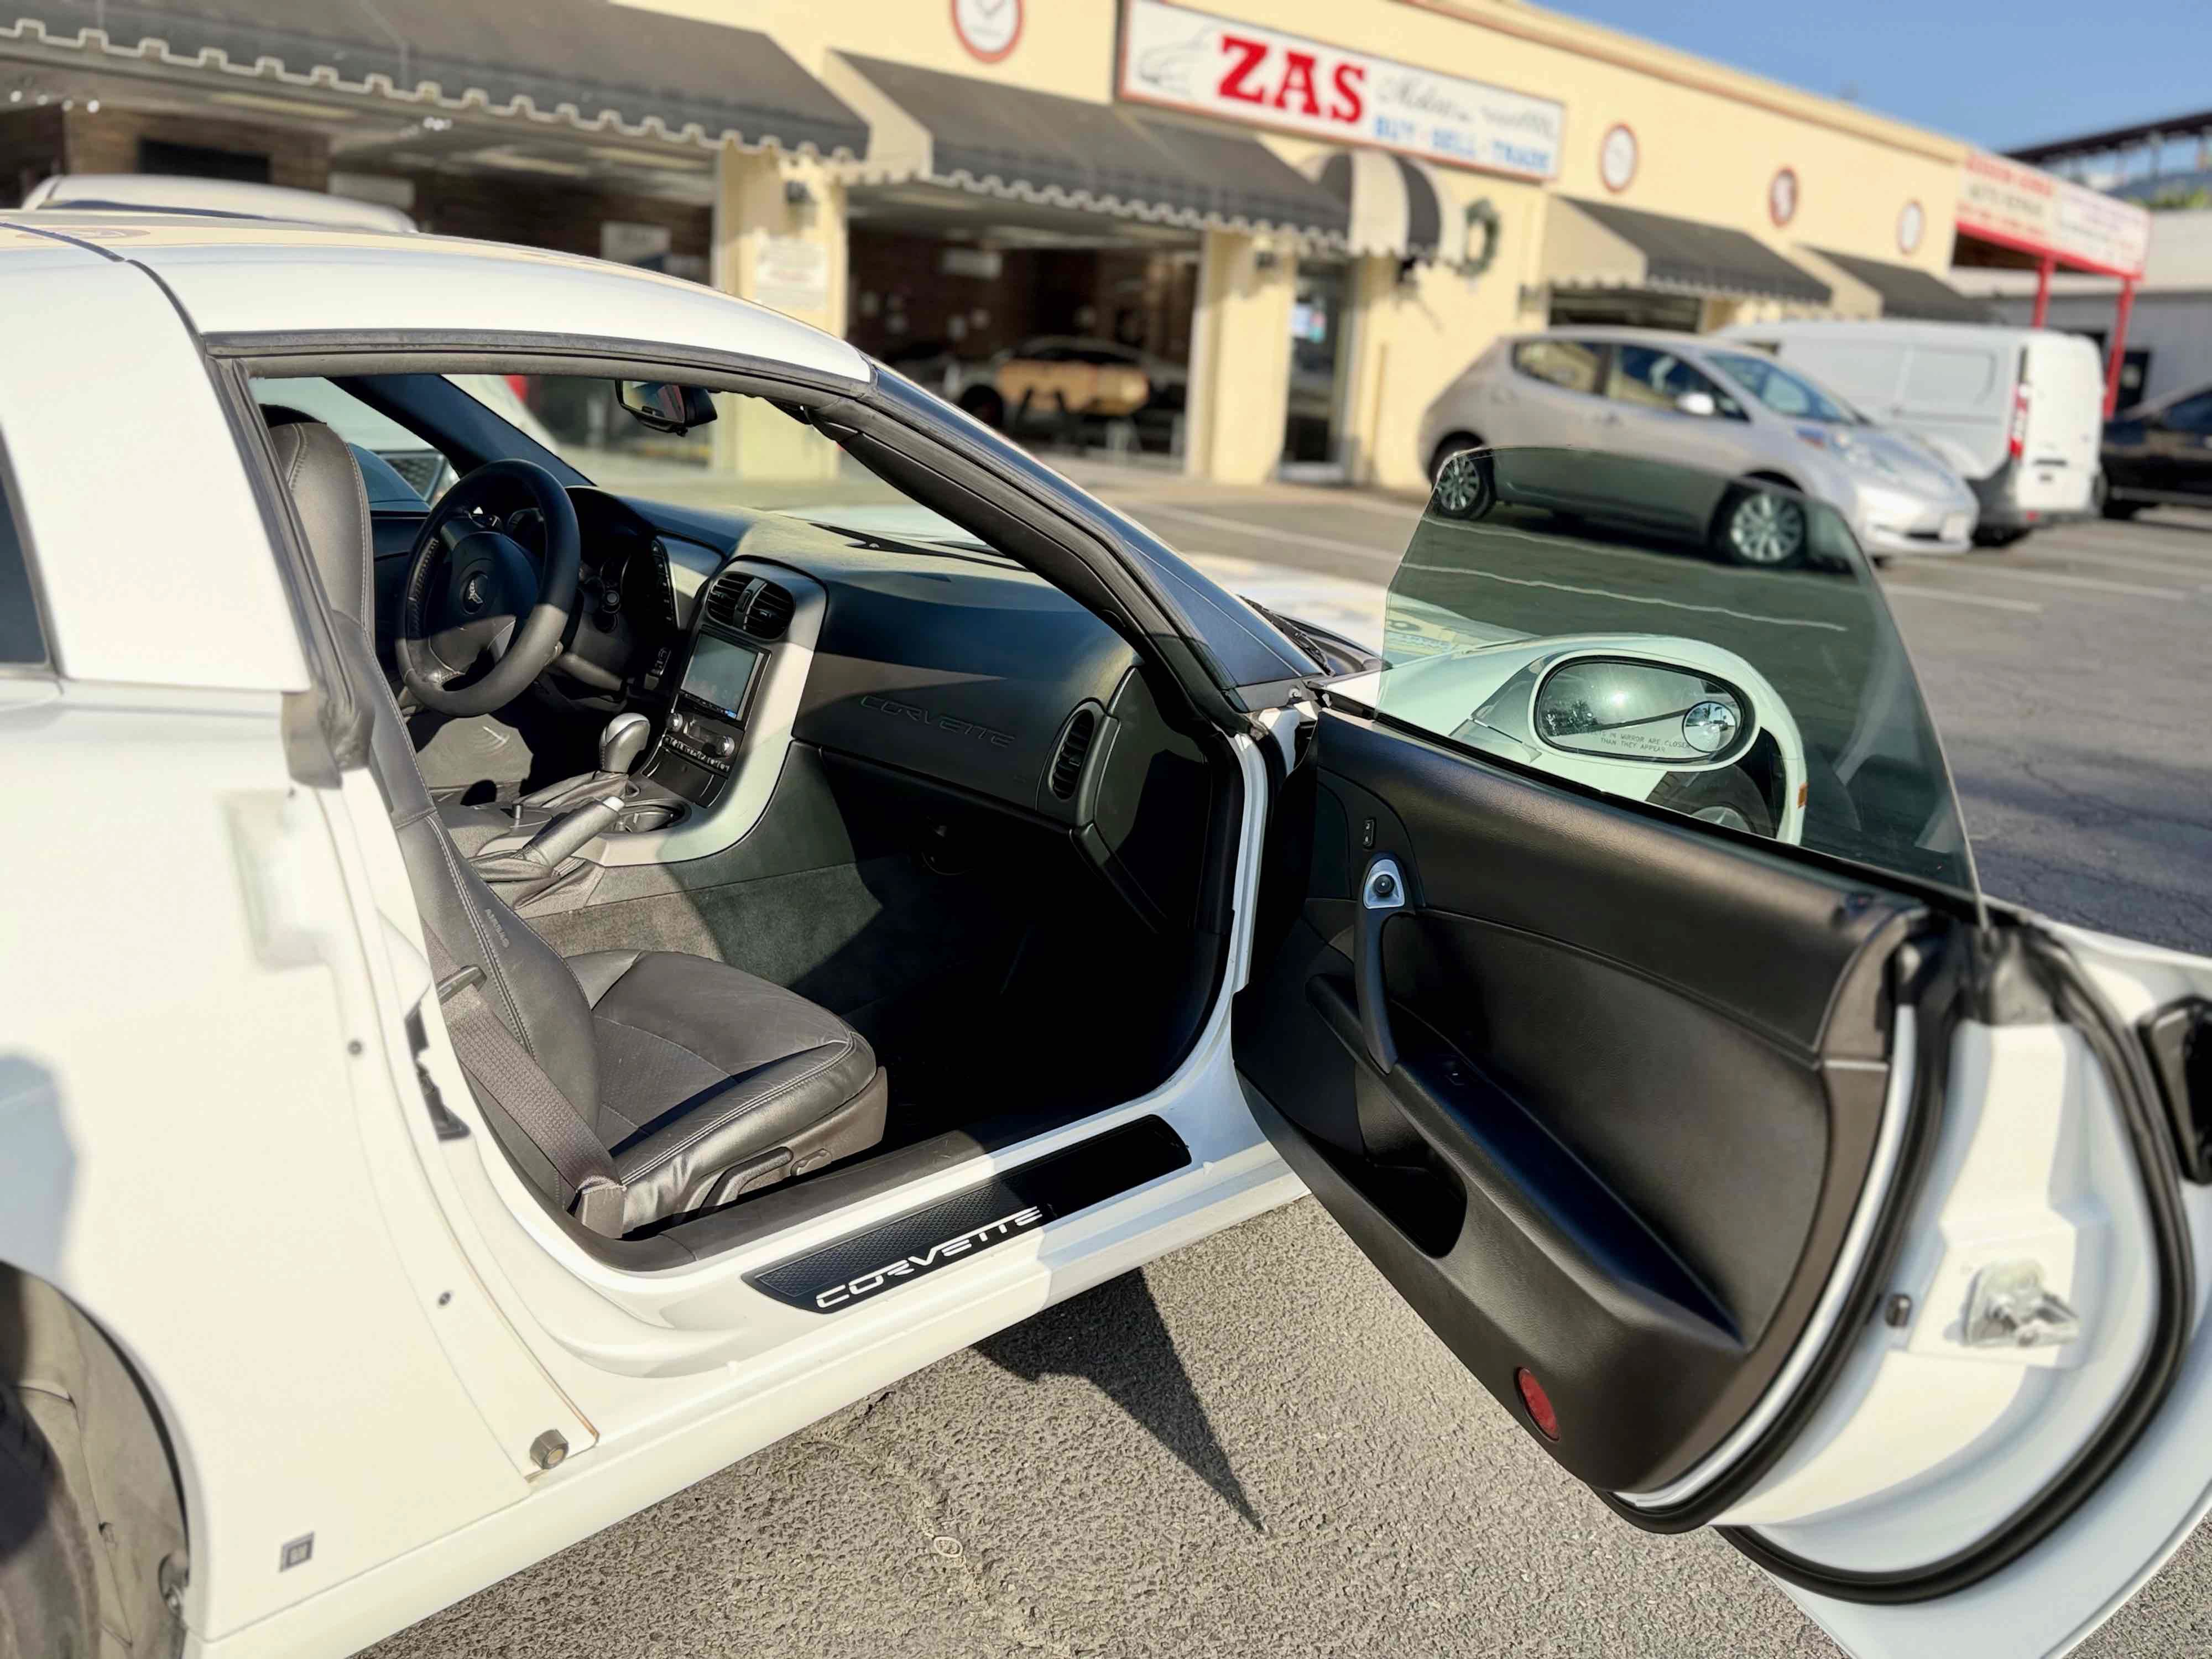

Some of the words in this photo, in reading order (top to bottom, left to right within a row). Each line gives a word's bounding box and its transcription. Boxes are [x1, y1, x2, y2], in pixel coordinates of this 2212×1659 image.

[1218, 35, 1364, 123] ZAS
[1375, 115, 1414, 139] BUY
[1431, 128, 1477, 157] SELL
[1491, 140, 1550, 169] TRADE
[860, 695, 1015, 748] CORVETTE
[1601, 737, 1616, 745] THAN
[1640, 744, 1666, 753] APPEAR
[1620, 733, 1645, 743] MIRROR
[816, 1206, 1042, 1309] CORVETTE
